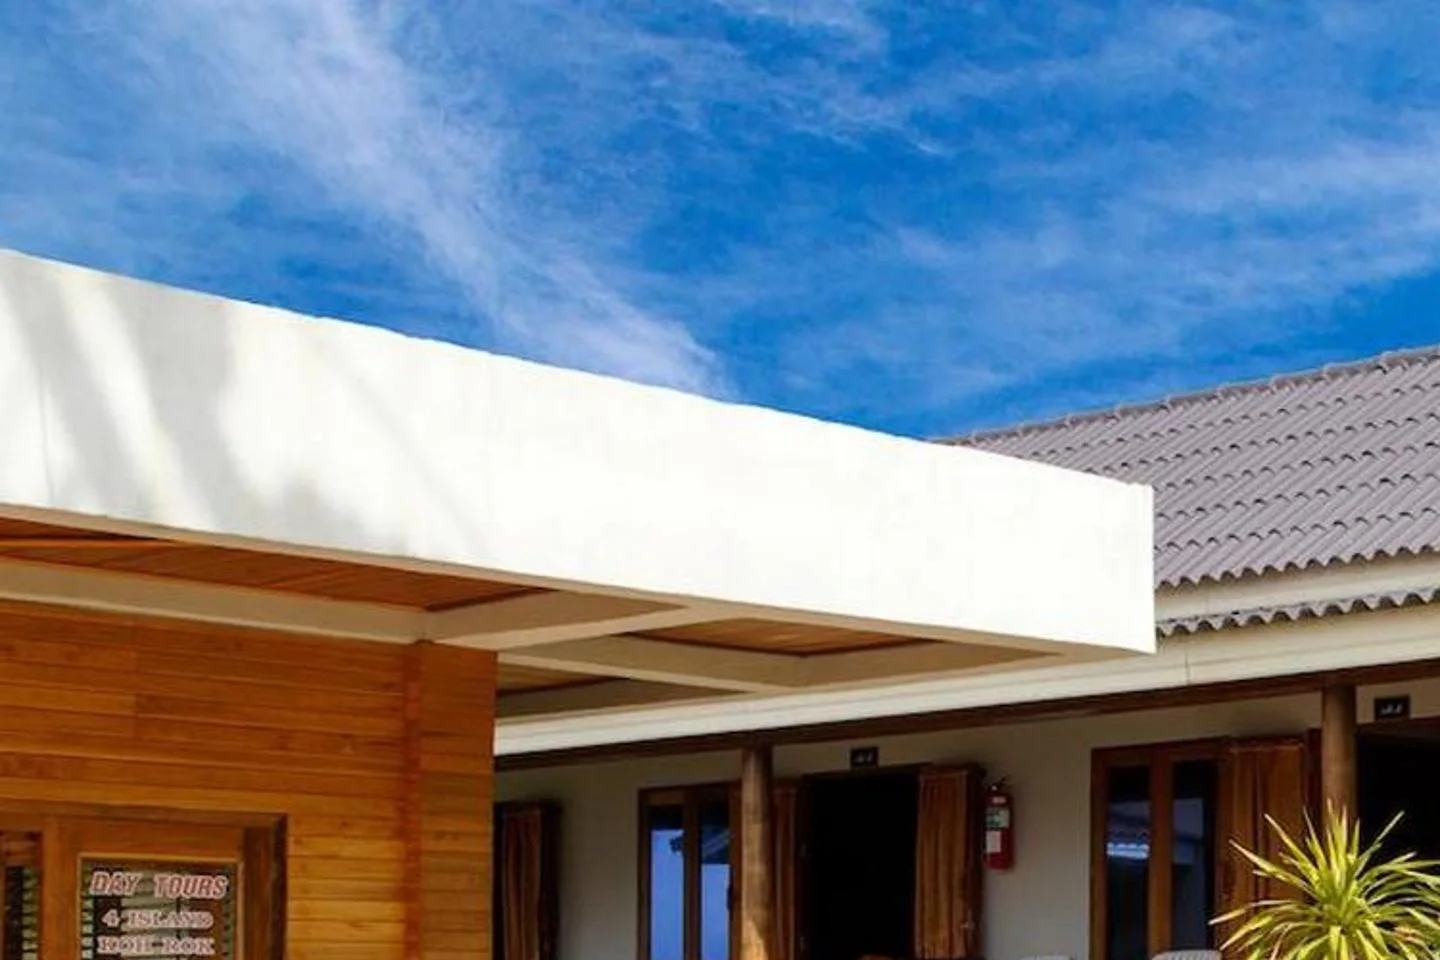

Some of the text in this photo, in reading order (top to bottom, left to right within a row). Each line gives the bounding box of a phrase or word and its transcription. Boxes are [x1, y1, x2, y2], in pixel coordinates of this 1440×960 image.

[90, 871, 229, 899] DAY TOURS
[102, 909, 121, 927] 4
